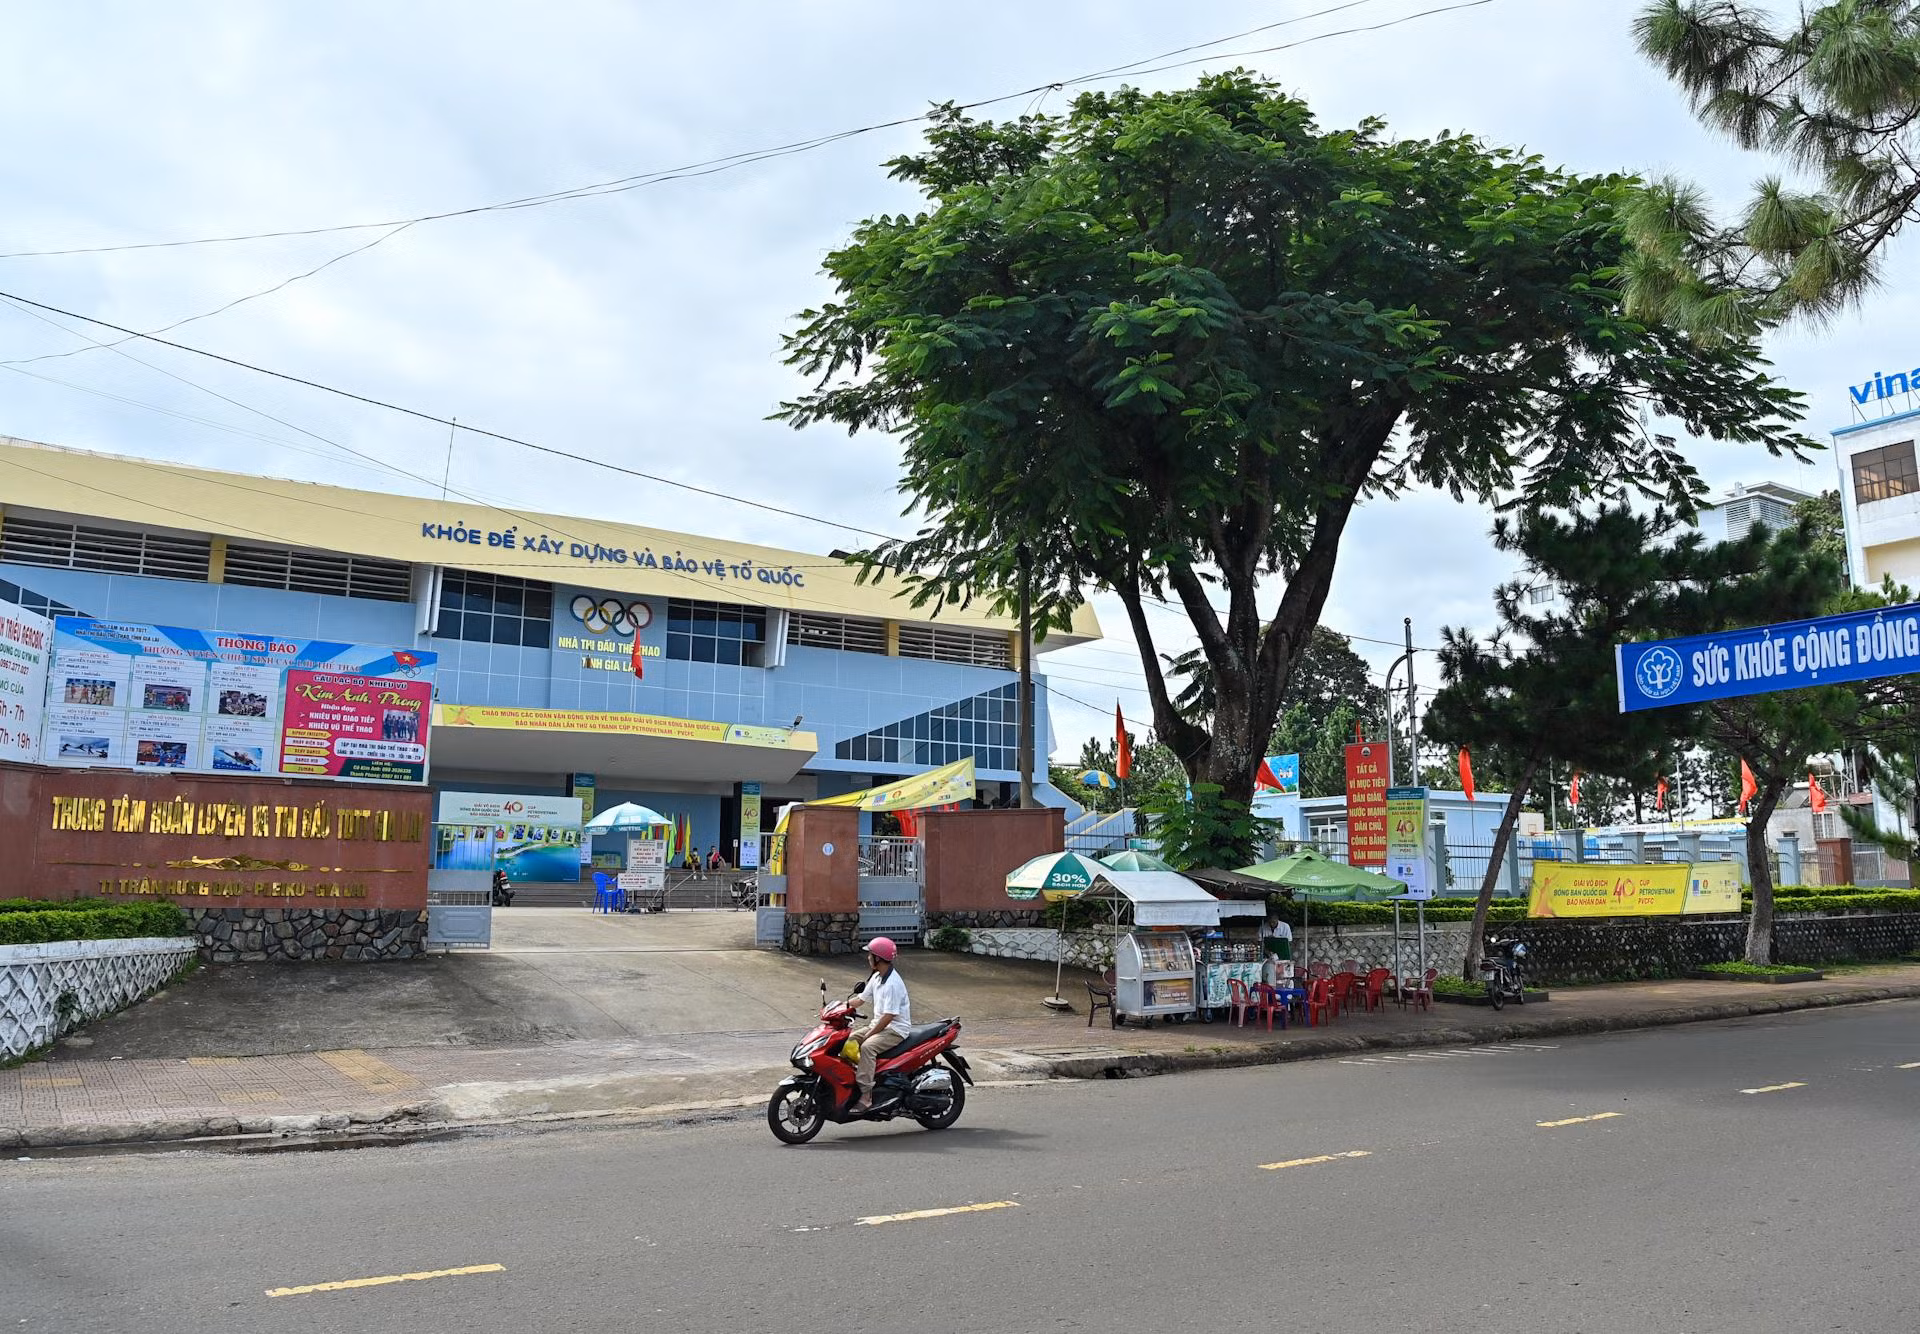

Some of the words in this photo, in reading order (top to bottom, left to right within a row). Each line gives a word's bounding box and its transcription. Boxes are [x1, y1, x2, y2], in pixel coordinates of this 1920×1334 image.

[1849, 367, 1920, 404] vina
[421, 520, 482, 546] KHỎE
[487, 526, 517, 549] ĐỂ
[523, 534, 564, 555] XÂY
[570, 544, 628, 564] DỰNG
[633, 547, 658, 569] VÀ
[662, 551, 698, 574] BẢO
[702, 558, 726, 582] VỆ
[730, 559, 753, 580] TỔ
[757, 566, 805, 587] QUỐC
[216, 637, 265, 651] THÔNG
[269, 640, 297, 654] BÁO
[558, 636, 578, 650] NHÀ
[581, 638, 595, 651] THI
[597, 638, 616, 654] ĐẤU
[617, 639, 635, 654] THỂ
[1692, 642, 1730, 687] SỨC
[1735, 629, 1787, 681] KHỎE
[1793, 626, 1850, 679] CỘNG
[1856, 611, 1920, 664] ĐỒNG
[581, 656, 603, 670] TNH
[604, 658, 621, 671] GIA
[11, 680, 24, 695] CỬA
[294, 683, 334, 702] Kim
[377, 691, 422, 712] Phong
[15, 704, 25, 721] 7h
[309, 711, 331, 721] KHIÊU
[332, 712, 341, 721] VŨ
[342, 714, 359, 723] GIAO
[360, 714, 376, 724] TIẾP
[308, 721, 330, 730] KHIÊU
[330, 722, 340, 731] VŨ
[341, 722, 355, 732] THỂ
[356, 724, 373, 733] THAO
[17, 732, 31, 749] 19h
[1356, 761, 1367, 774] TẤT
[1368, 761, 1377, 773] CẢ
[1349, 779, 1357, 788] VÌ
[1357, 780, 1371, 789] MỤC
[1372, 778, 1386, 788] TIÊU
[1353, 793, 1366, 803] DÂN
[504, 801, 524, 815] 40
[1349, 805, 1366, 817] NƯỚC
[51, 796, 106, 831] TRUNG
[111, 794, 146, 832] TÂM
[150, 791, 195, 835] HUẤN
[197, 799, 247, 839] LUYỆN
[274, 806, 299, 838] THI
[301, 800, 332, 839] ĐẤU
[337, 809, 371, 841] TDTT
[374, 810, 396, 842] GIA
[1354, 821, 1367, 832] DÂN
[1396, 819, 1415, 837] 40
[1351, 835, 1368, 846] CÔNG
[1353, 849, 1366, 860] VĂN
[1052, 873, 1087, 883] 30%
[1586, 879, 1595, 887] VÔ
[118, 874, 161, 895] TRẦN
[165, 879, 209, 896] HƯNG
[213, 880, 243, 898] ĐẠO
[254, 881, 306, 898] PLEIKU
[315, 882, 340, 898] GIA
[343, 883, 367, 898] LAI
[1612, 877, 1635, 904] 40
[1638, 888, 1675, 896] PETROVIETNAM
